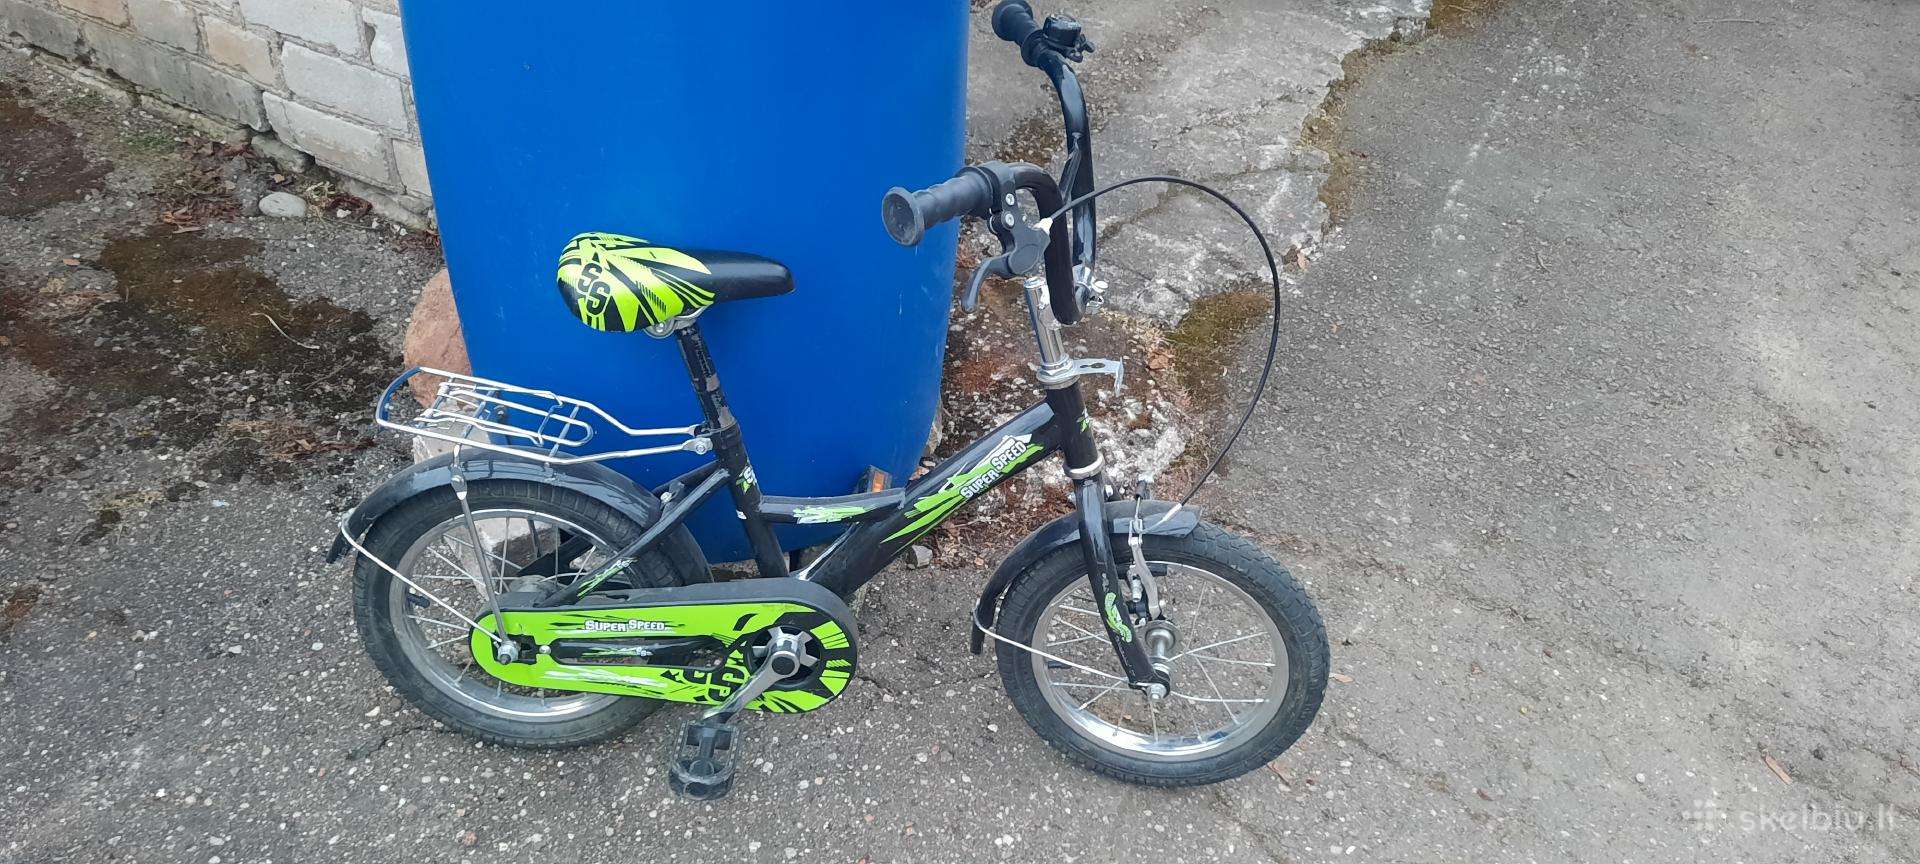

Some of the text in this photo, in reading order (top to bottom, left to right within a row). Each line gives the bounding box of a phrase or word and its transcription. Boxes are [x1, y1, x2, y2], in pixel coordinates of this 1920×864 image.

[960, 441, 1027, 498] SUPER SPEED
[584, 619, 666, 632] SUPER SPEED
